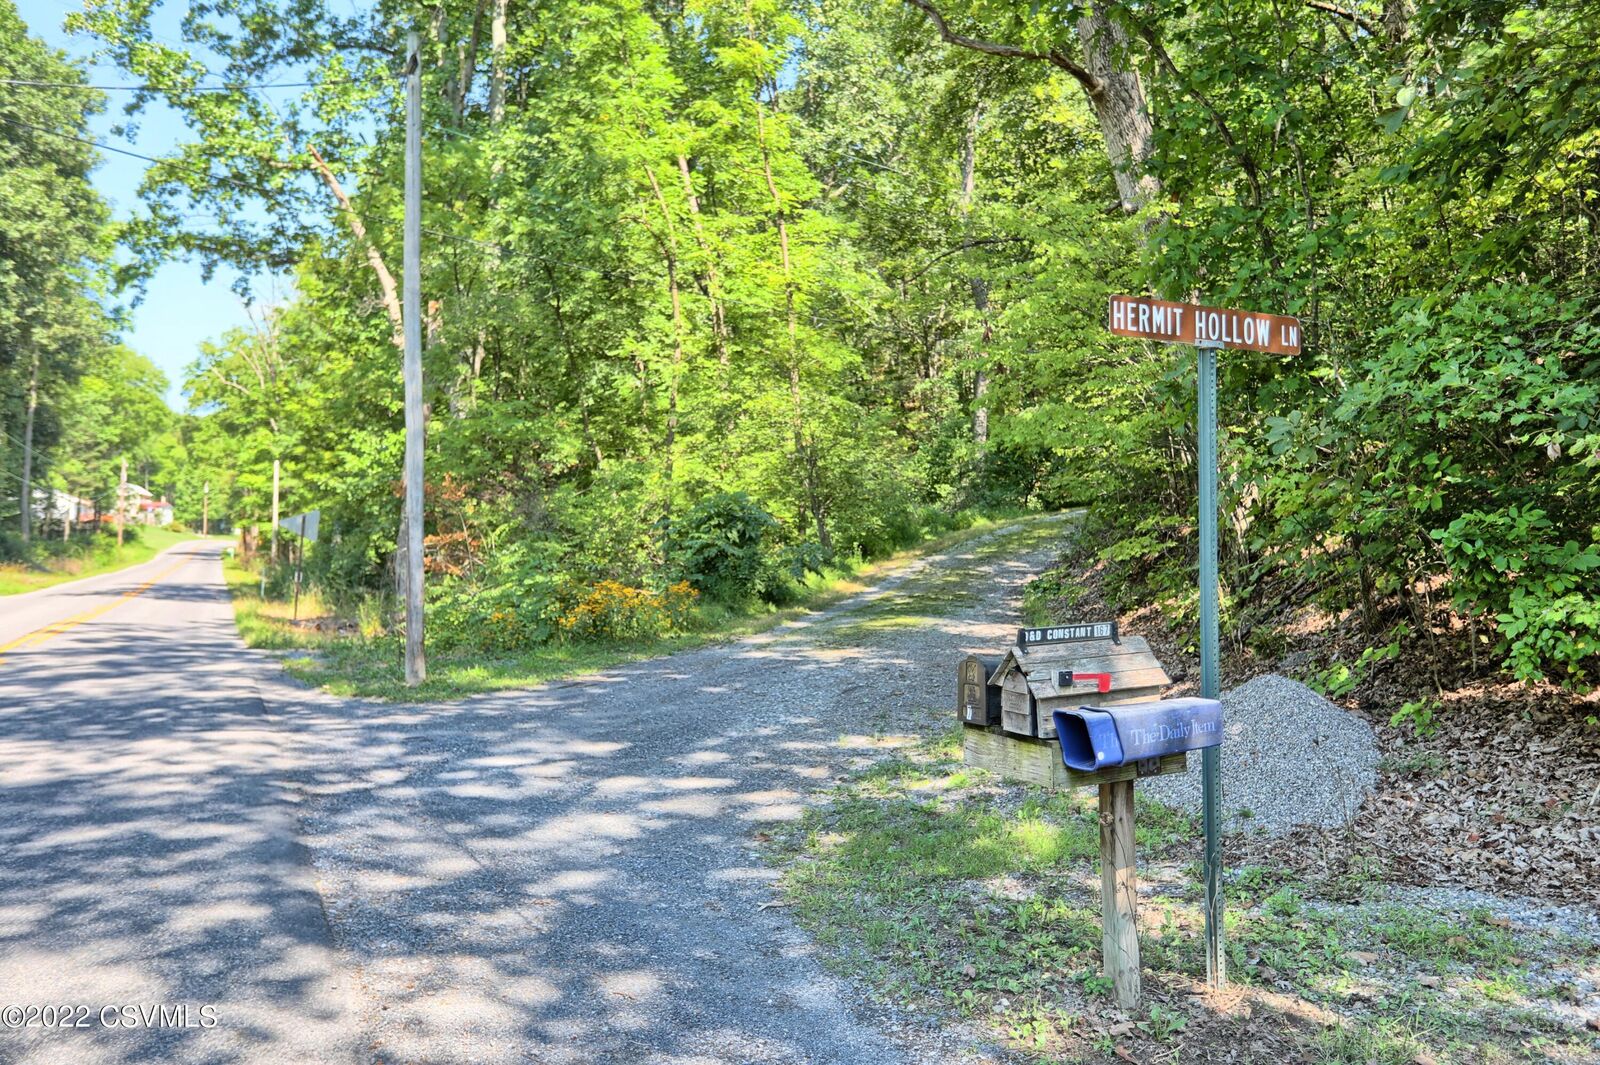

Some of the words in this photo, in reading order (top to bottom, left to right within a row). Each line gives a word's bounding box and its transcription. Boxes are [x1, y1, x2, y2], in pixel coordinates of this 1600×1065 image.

[1113, 301, 1183, 336] HERMIT
[1195, 310, 1270, 347] HOLLOW
[1281, 325, 1298, 347] LN
[1047, 627, 1092, 640] CONSTANT
[1130, 728, 1158, 746] The
[1159, 722, 1191, 741] Daily
[1190, 719, 1216, 737] Item
